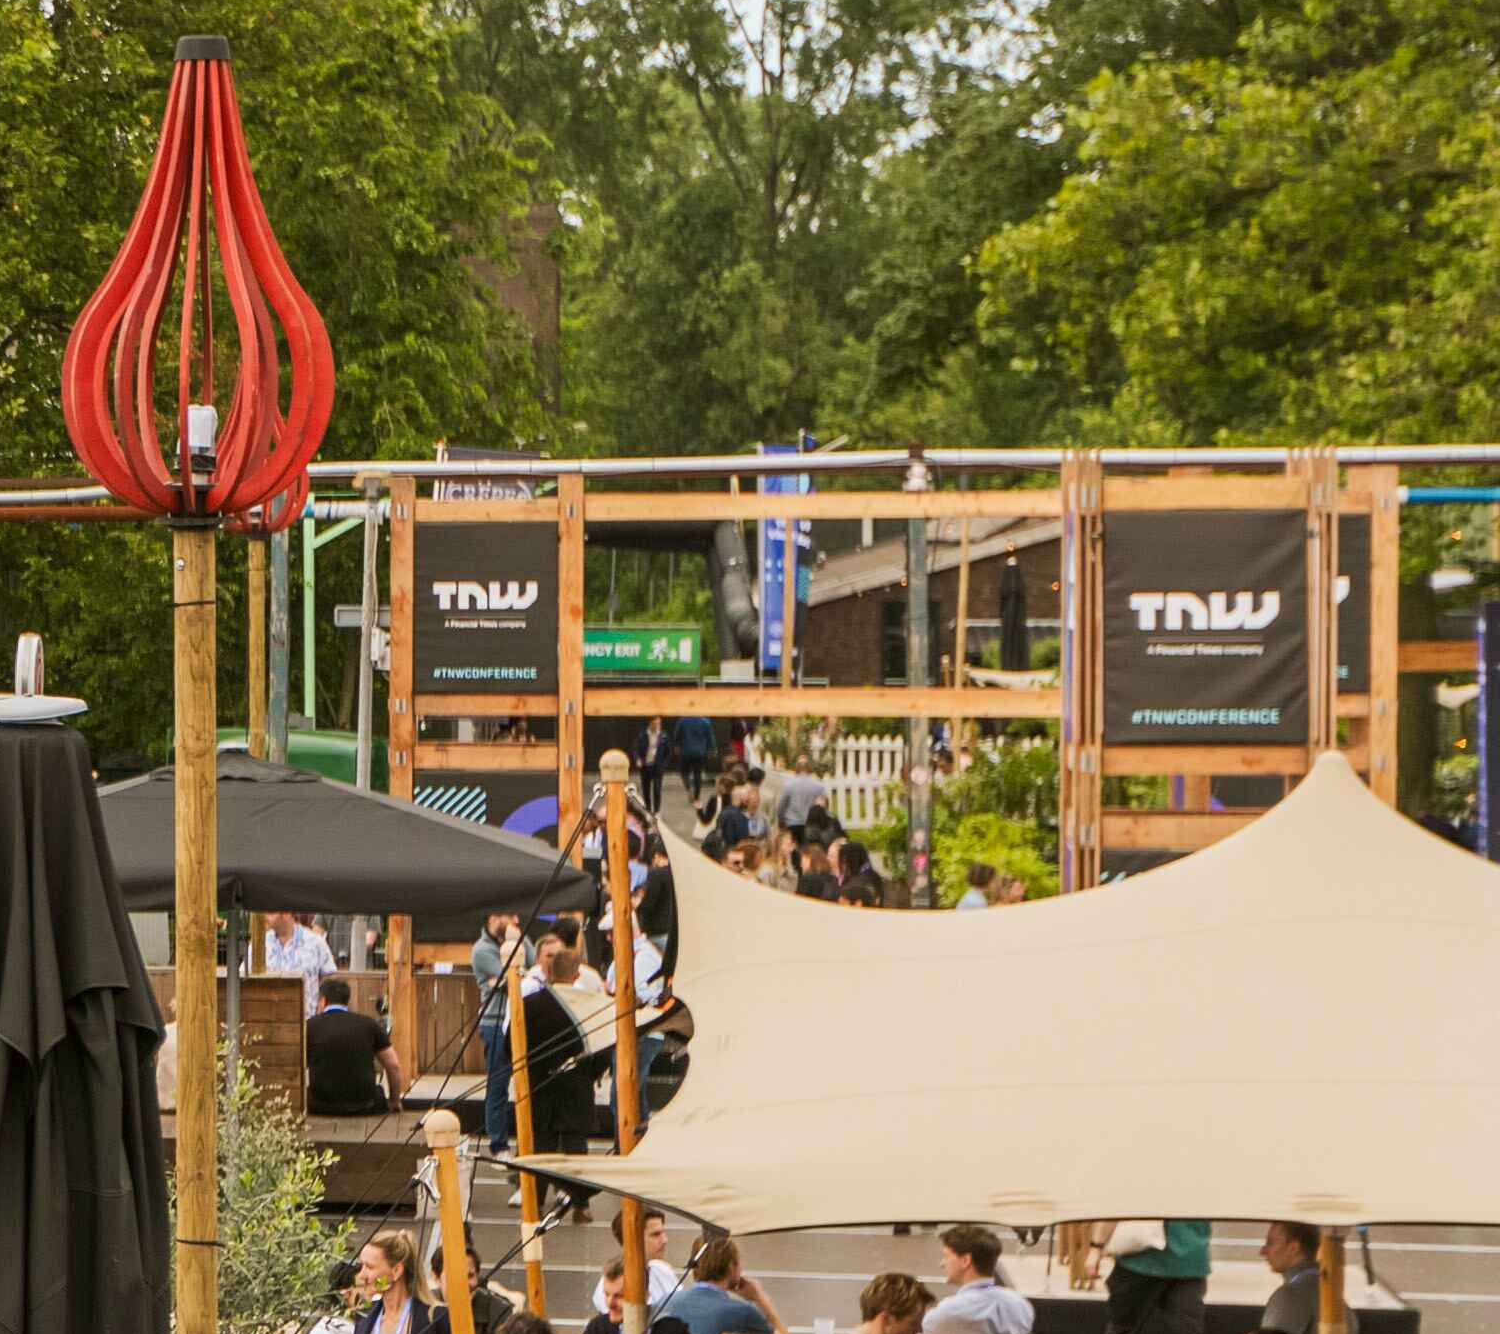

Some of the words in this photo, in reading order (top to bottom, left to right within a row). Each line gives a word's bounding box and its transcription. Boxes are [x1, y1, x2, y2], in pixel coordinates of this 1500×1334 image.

[432, 581, 539, 610] TNW
[1129, 590, 1281, 631] TNW
[451, 618, 479, 629] Financial
[480, 619, 498, 629] Times
[614, 641, 642, 658] EXIT
[1155, 644, 1196, 656] Financial
[1197, 644, 1223, 656] Times
[433, 667, 538, 680] #TNWCONFERENCE
[1132, 708, 1281, 726] #TNWCONFERENCE
